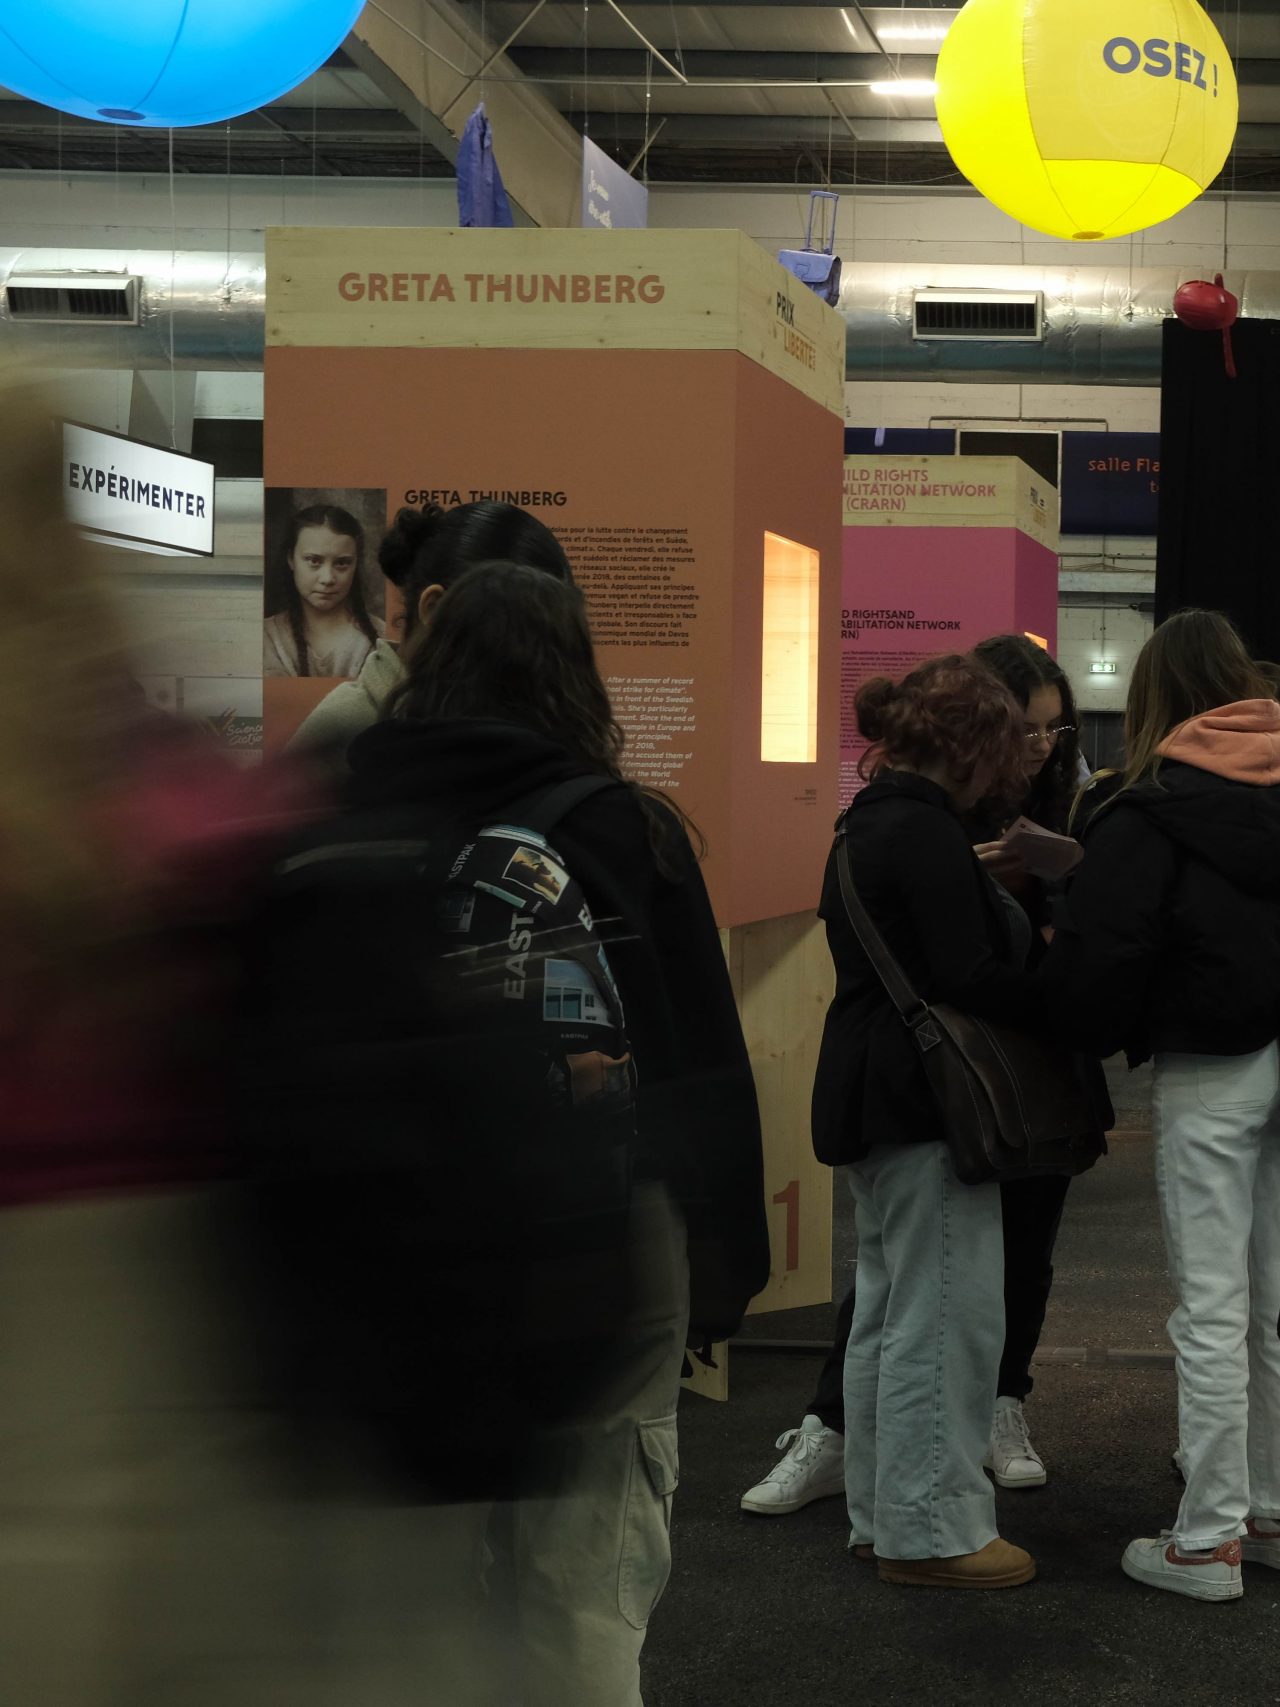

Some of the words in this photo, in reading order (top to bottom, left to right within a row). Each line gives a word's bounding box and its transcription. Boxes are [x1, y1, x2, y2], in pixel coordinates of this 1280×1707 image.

[1103, 37, 1206, 91] OSEZ
[338, 272, 456, 302] GRETA
[464, 273, 666, 304] THUNBERG
[776, 291, 795, 328] PRIX
[1089, 457, 1131, 472] salle
[874, 469, 929, 481] RIGHTS
[69, 462, 206, 518] EXPÉRIMENTER
[404, 490, 463, 505] GRETA
[469, 490, 568, 507] THUNBERG
[920, 484, 997, 498] NETWORK
[846, 497, 906, 511] (CRARN)
[852, 610, 916, 619] RIGHTSAND
[907, 620, 961, 630] NETWORK
[503, 911, 535, 1000] EAST
[773, 1180, 800, 1272] 1
